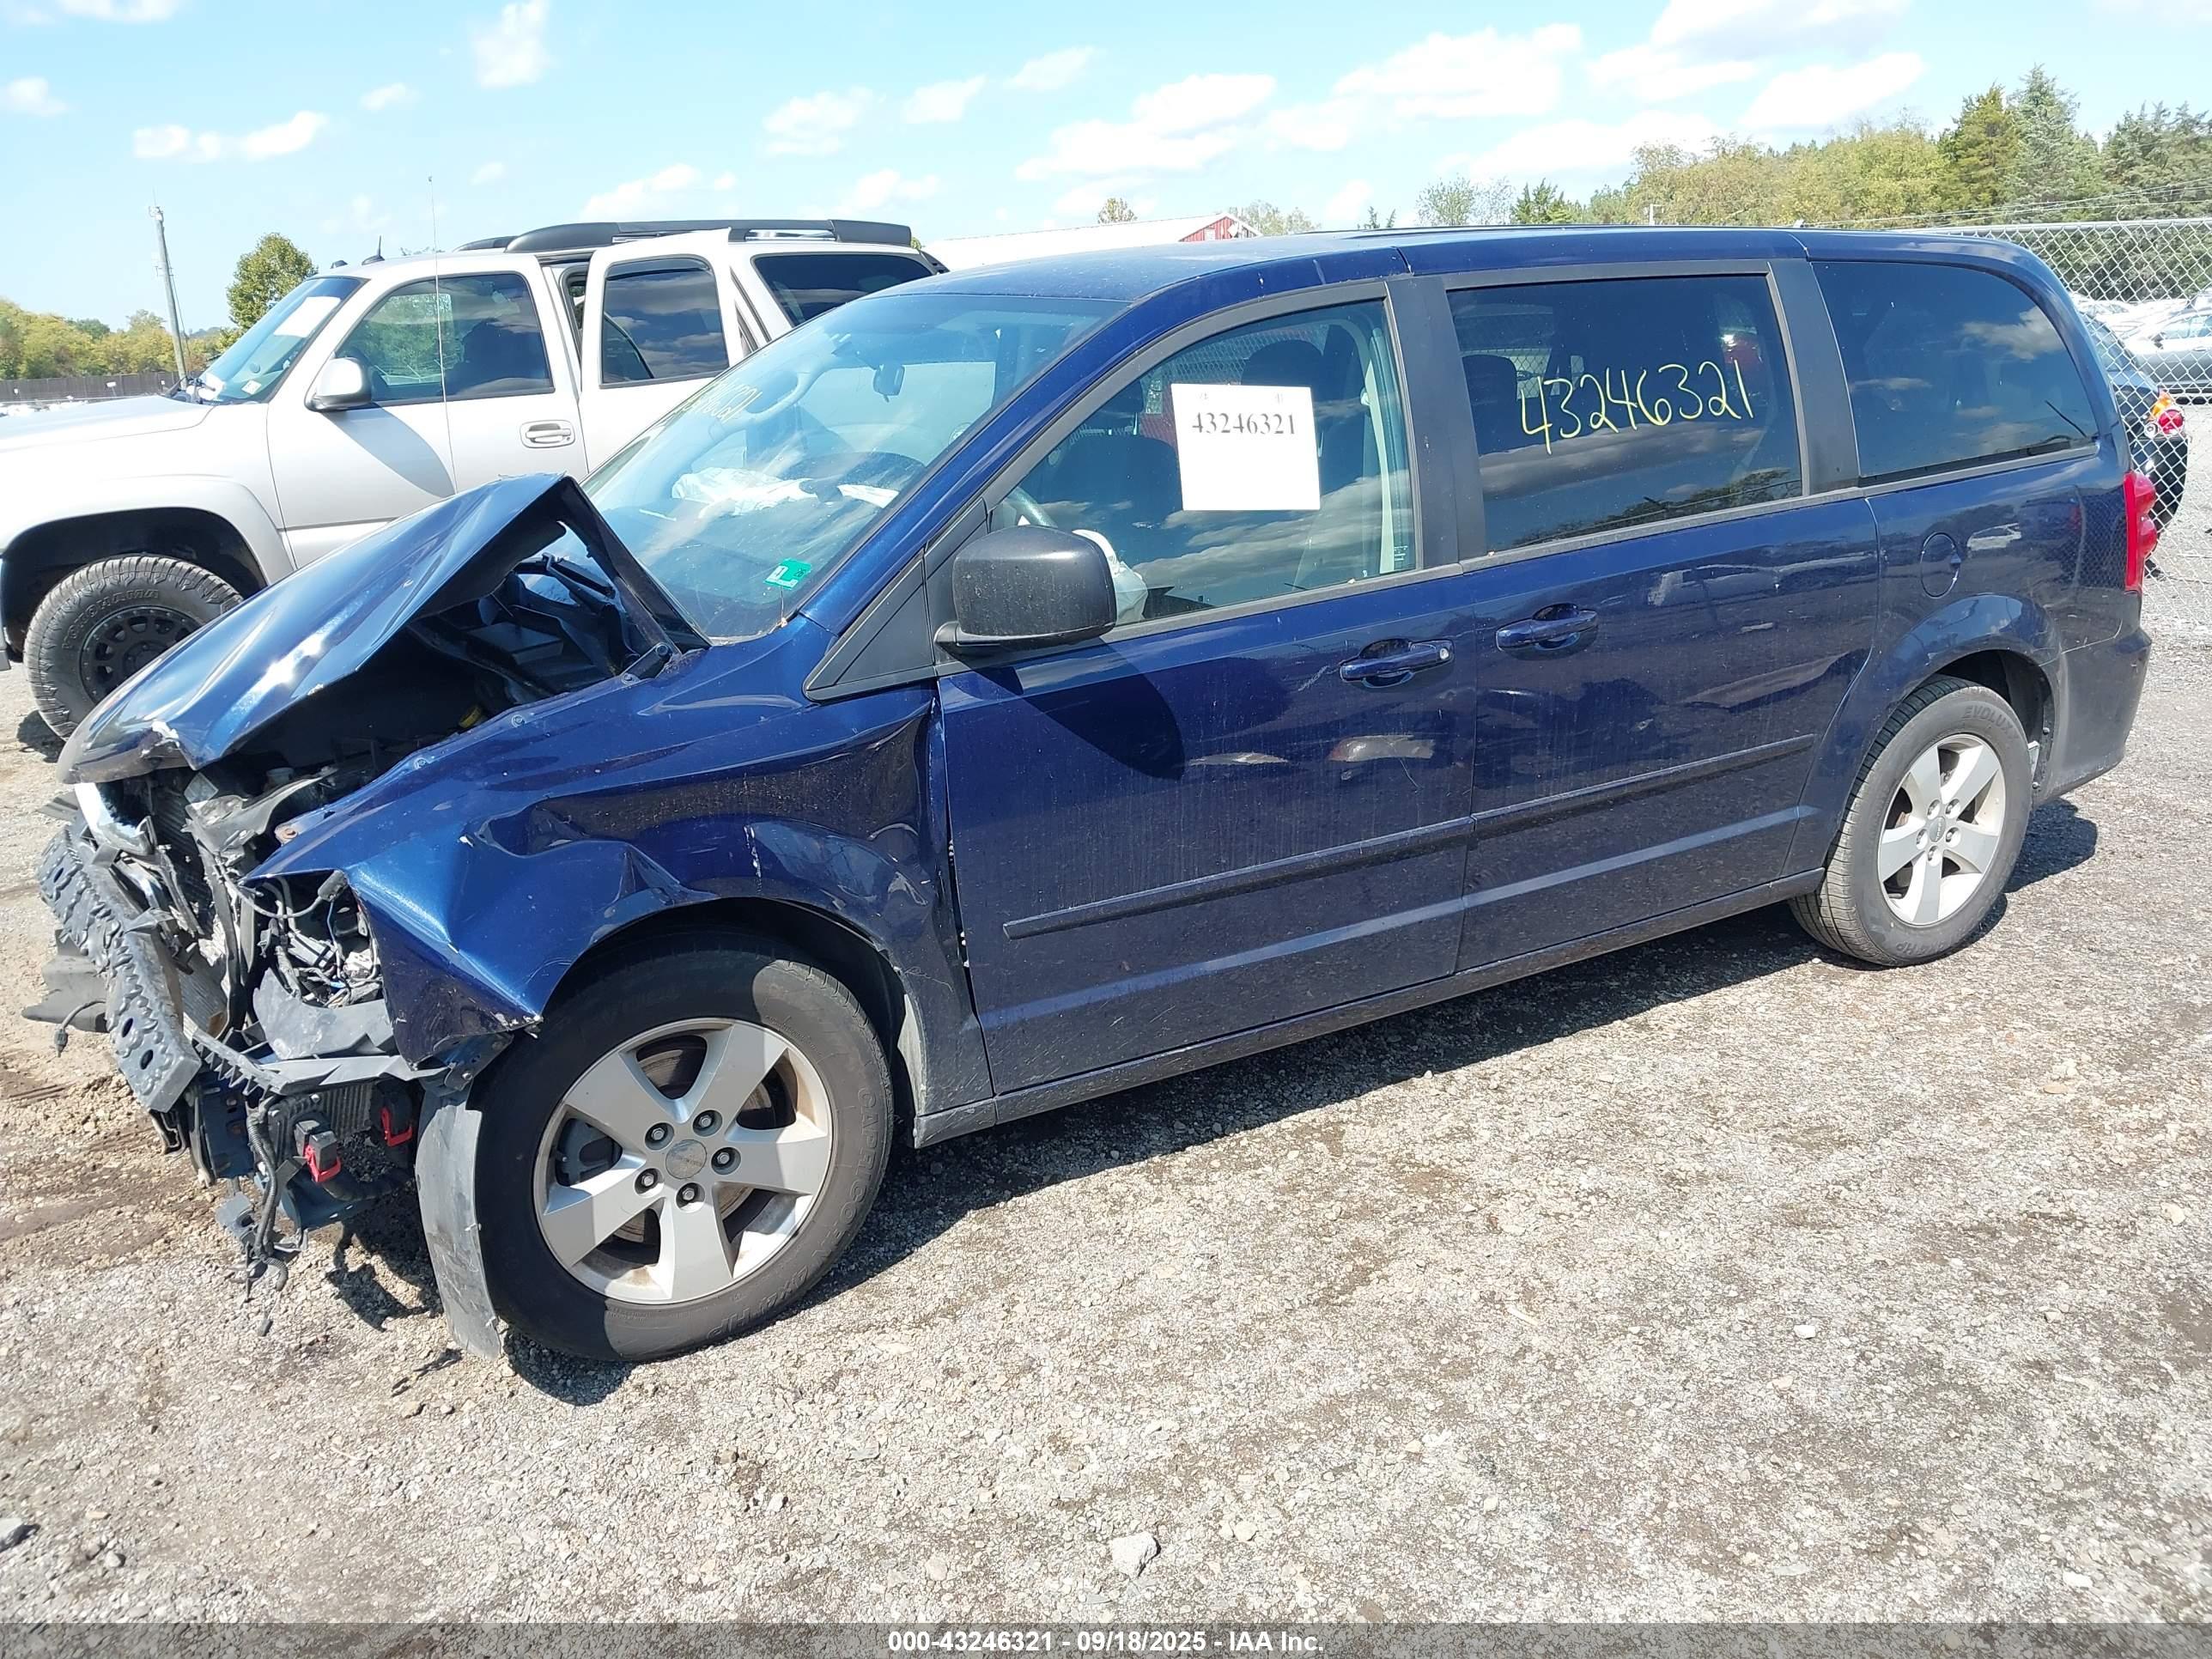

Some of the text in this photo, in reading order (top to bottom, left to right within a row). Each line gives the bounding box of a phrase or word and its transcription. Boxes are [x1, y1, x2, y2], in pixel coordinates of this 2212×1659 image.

[1192, 412, 1295, 434] 43246321
[1521, 359, 1753, 455] 43246321
[62, 589, 159, 649] YOKOHAMA
